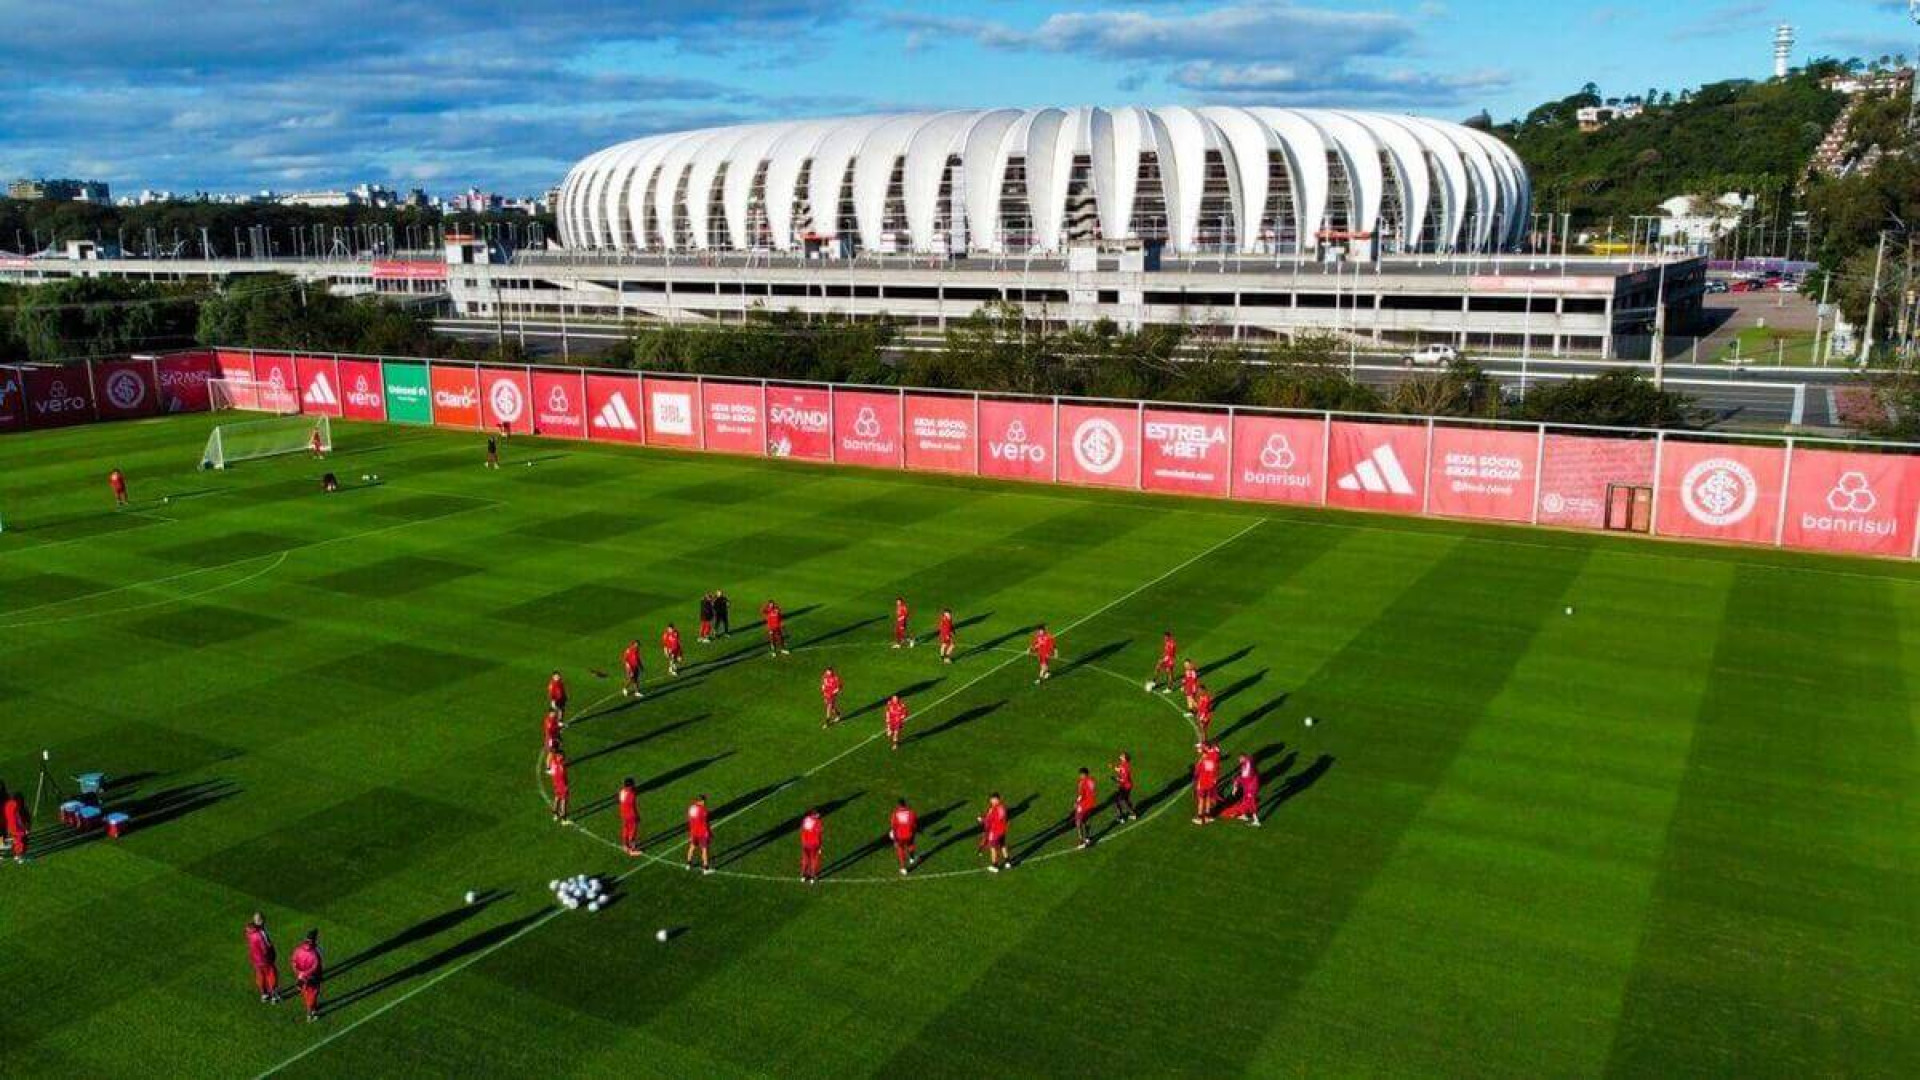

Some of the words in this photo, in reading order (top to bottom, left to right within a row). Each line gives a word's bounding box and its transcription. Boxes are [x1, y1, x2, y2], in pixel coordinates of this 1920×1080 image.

[35, 397, 85, 413] vero
[346, 391, 380, 407] vero
[436, 391, 470, 408] Claro
[770, 407, 828, 427] SARANDI
[1145, 422, 1226, 444] ESTRELA
[843, 437, 894, 453] banrisul
[990, 441, 1045, 462] vero
[1174, 441, 1209, 459] BET
[1244, 468, 1311, 488] banrisul
[1802, 511, 1897, 535] banrisul
